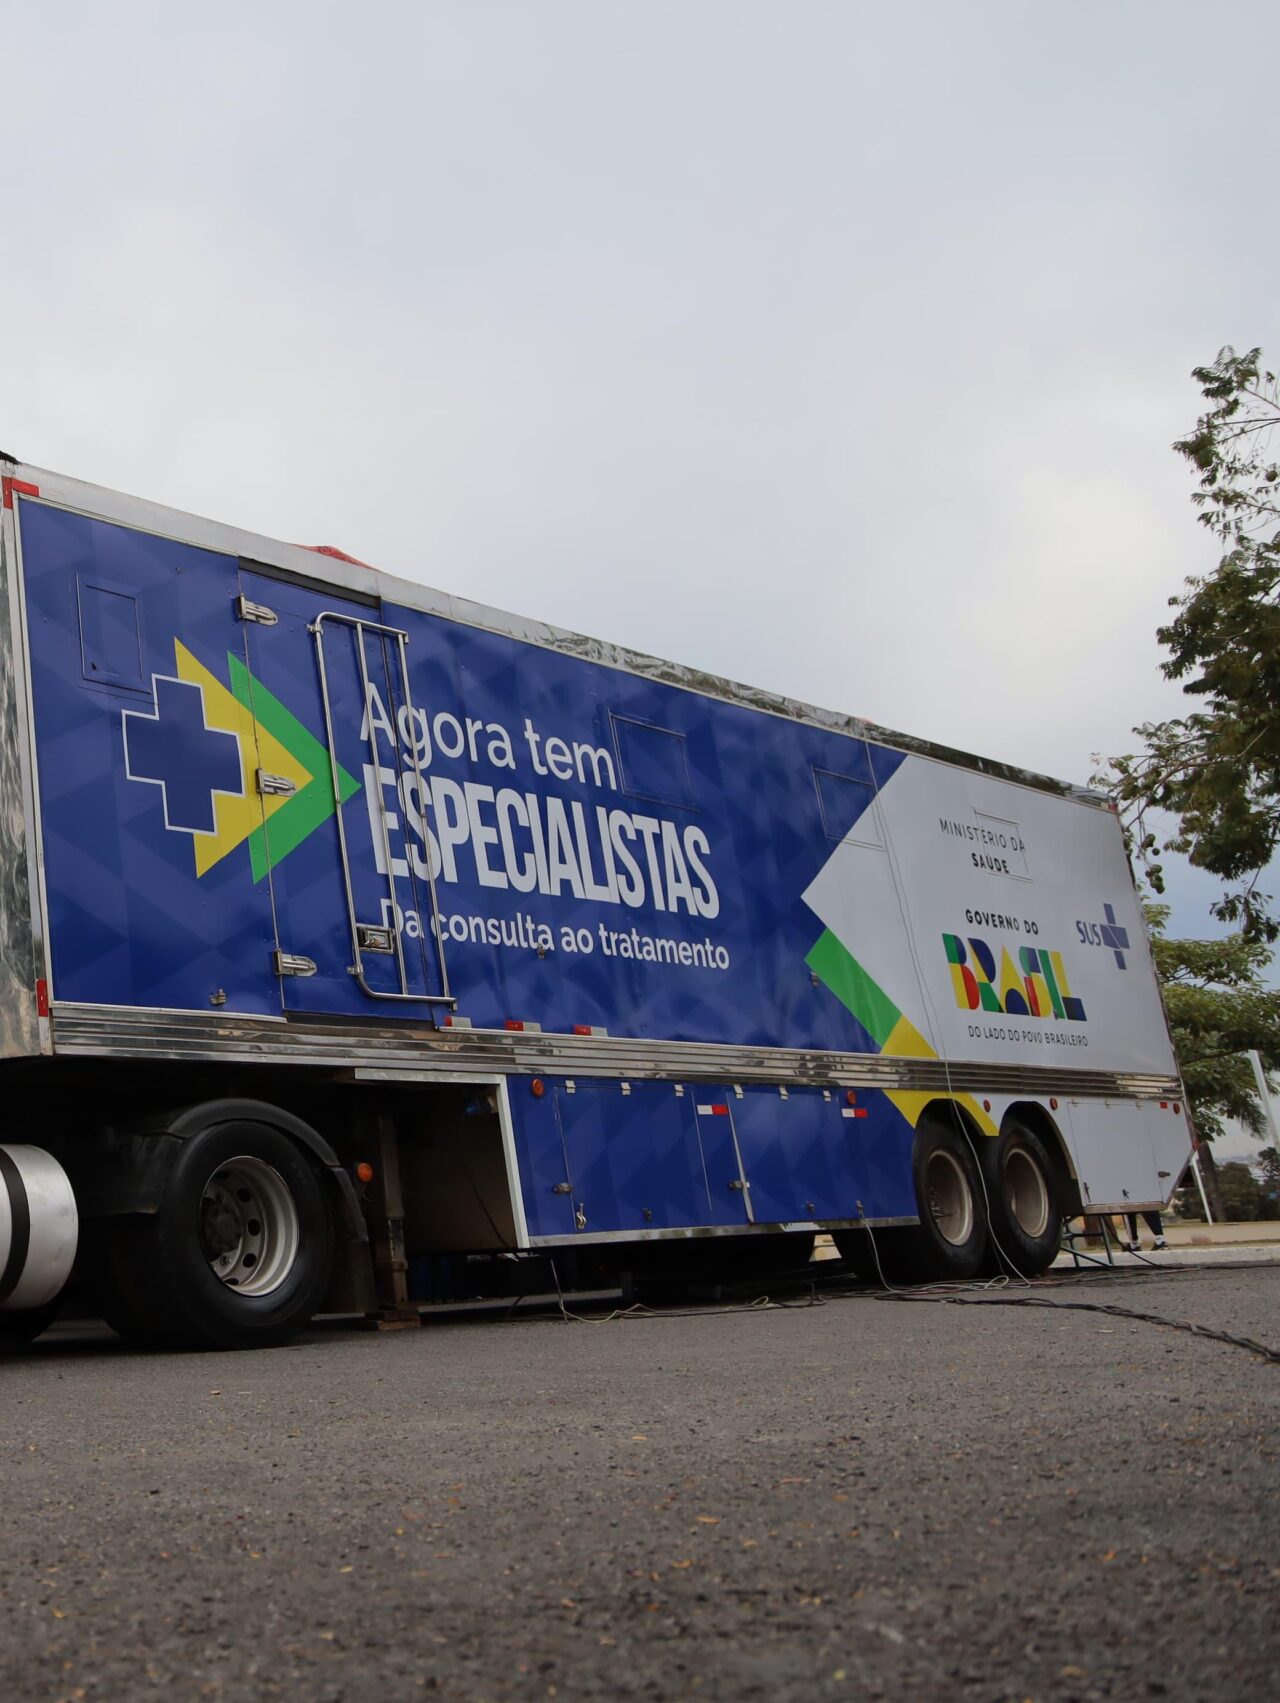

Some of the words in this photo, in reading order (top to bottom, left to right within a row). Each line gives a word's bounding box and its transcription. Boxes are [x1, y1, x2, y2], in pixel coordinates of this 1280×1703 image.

[359, 681, 516, 769] Agora
[524, 718, 617, 790] tem
[362, 763, 719, 920] ESPECIALISTAS
[1010, 836, 1026, 853] DA
[380, 897, 425, 939] Da
[431, 912, 555, 951] consulta
[560, 926, 594, 954] ao
[599, 922, 730, 970] tratamento
[965, 908, 1020, 931] GOVERNO
[1024, 919, 1039, 935] DO
[1076, 920, 1102, 946] SUS
[941, 932, 1088, 1021] BRASIL
[968, 1025, 981, 1038] DO
[983, 1026, 1006, 1041] LADO
[1008, 1029, 1020, 1042] DO
[1022, 1030, 1043, 1044] POVO
[1044, 1032, 1089, 1047] BRASILEIRO
